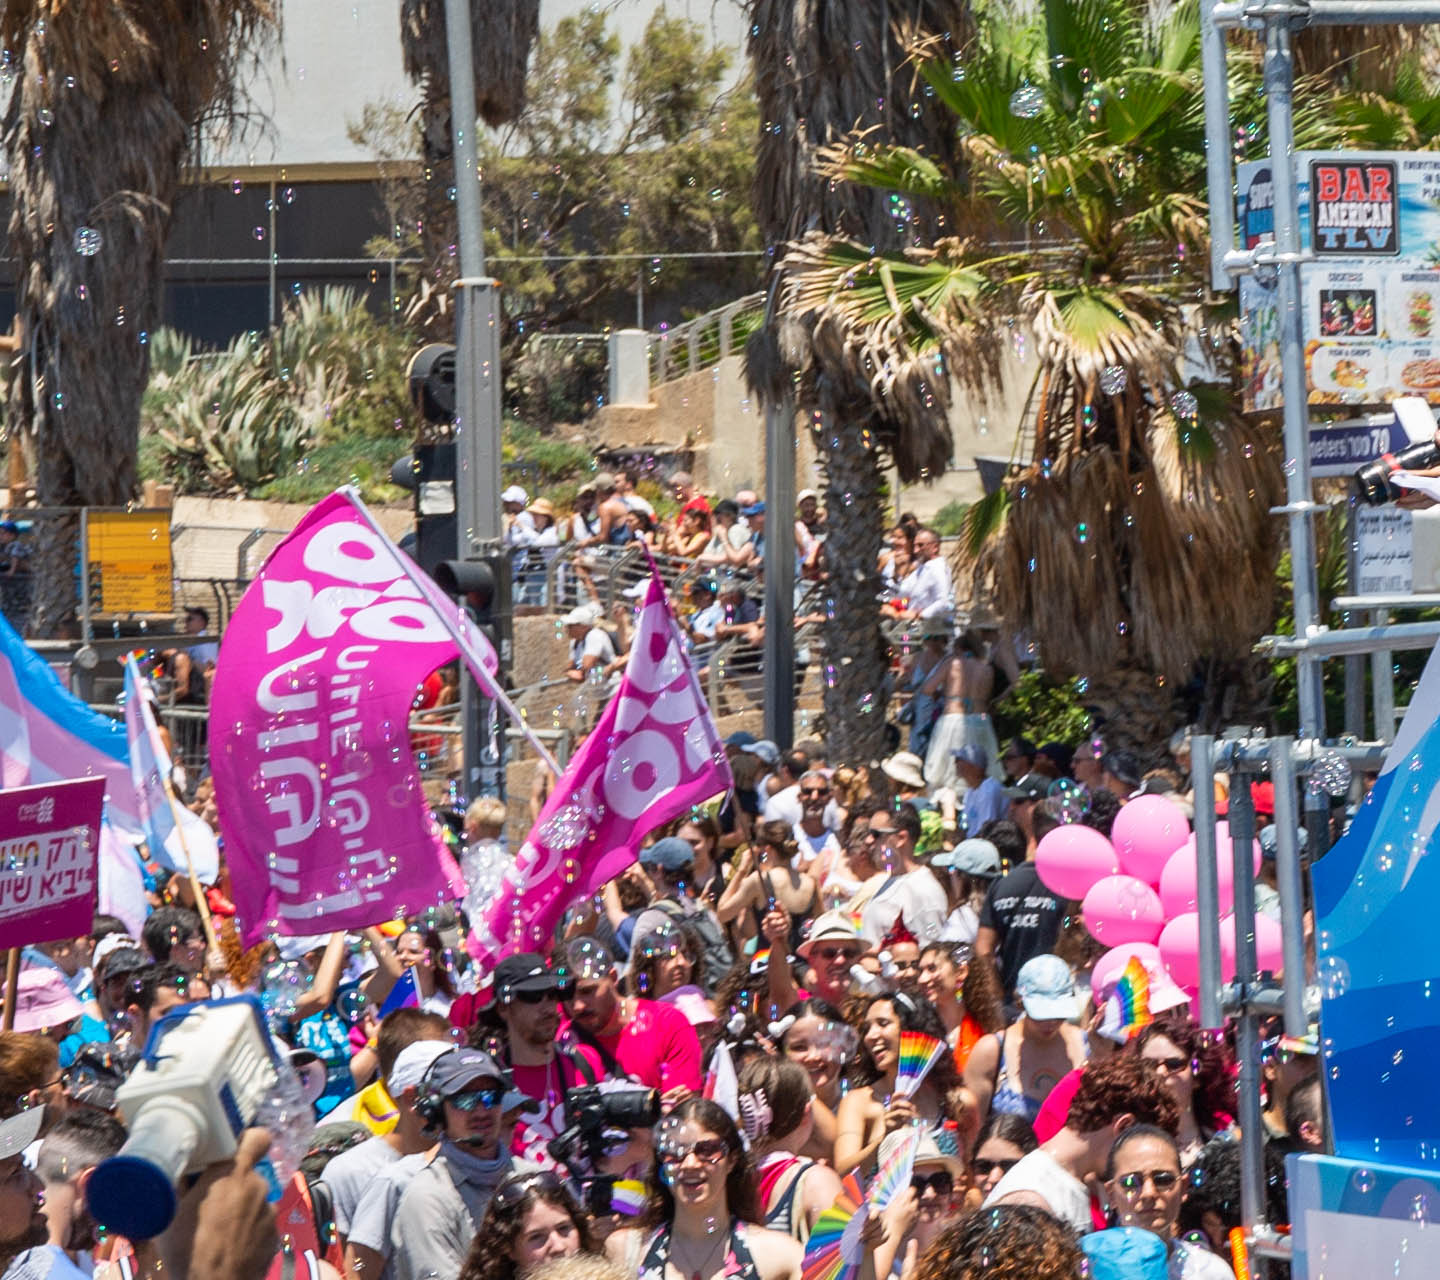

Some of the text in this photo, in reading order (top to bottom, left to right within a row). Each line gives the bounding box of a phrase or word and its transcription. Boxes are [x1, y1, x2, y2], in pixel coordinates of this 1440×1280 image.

[1317, 167, 1392, 201] BAR
[1317, 202, 1393, 228] AMERICAN
[1318, 227, 1393, 249] TLV
